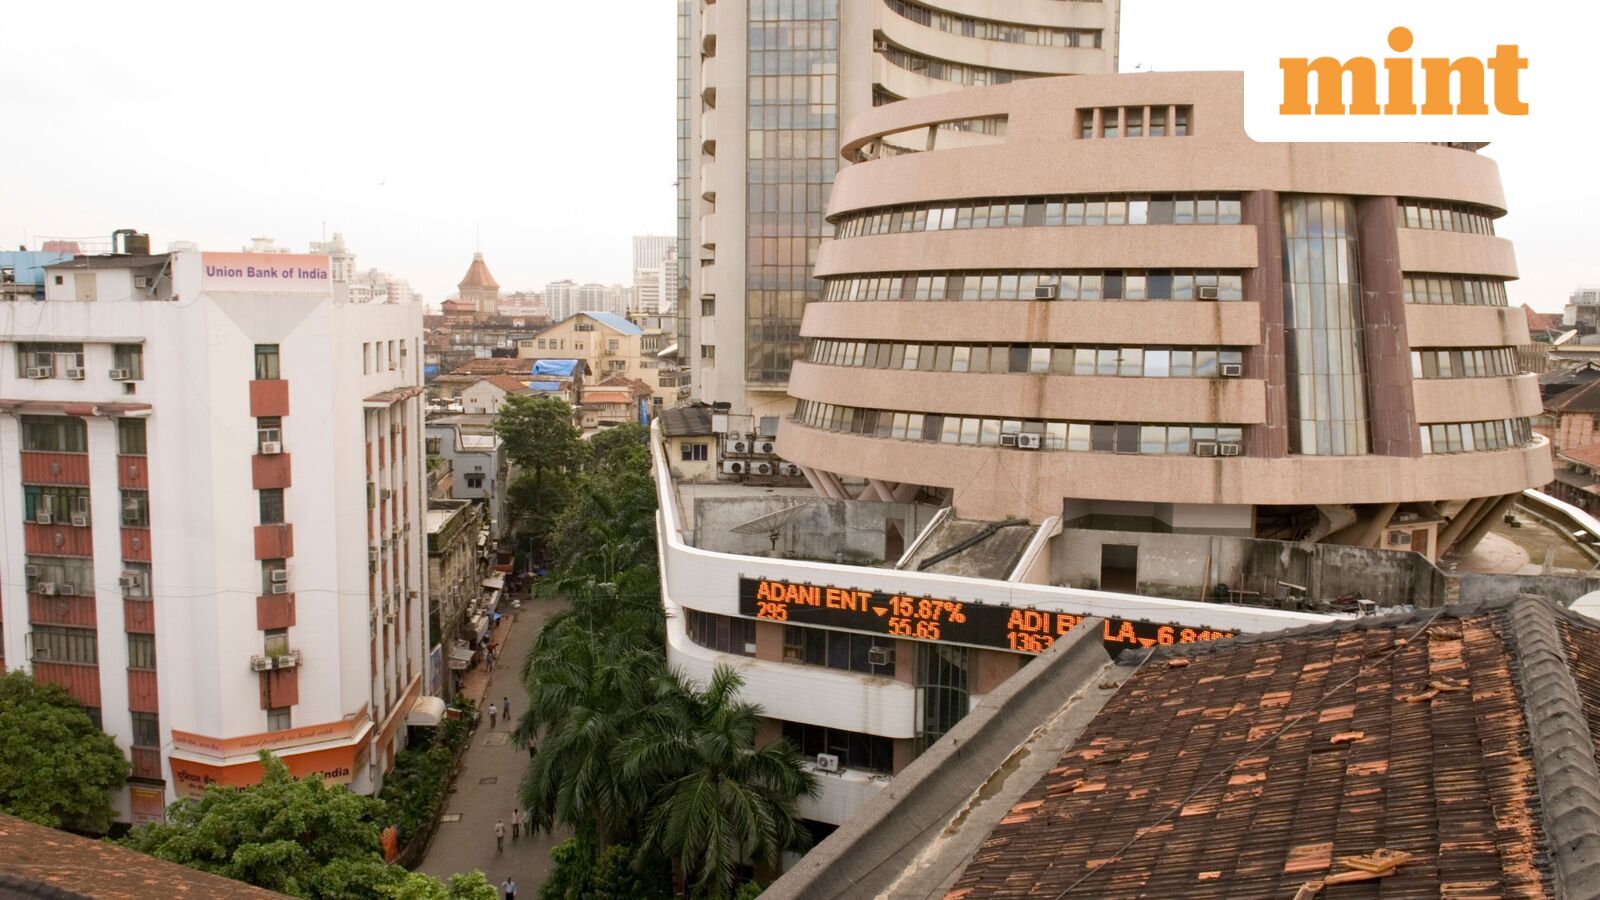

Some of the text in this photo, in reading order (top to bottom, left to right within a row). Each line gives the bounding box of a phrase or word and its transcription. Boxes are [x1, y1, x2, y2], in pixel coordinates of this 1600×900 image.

[206, 265, 328, 280] Union Bank of India
[756, 580, 967, 624] ADANI ENT 15.87%
[756, 601, 941, 640] 295 55.65
[1007, 609, 1050, 633] ADI
[321, 766, 350, 779] ndia
